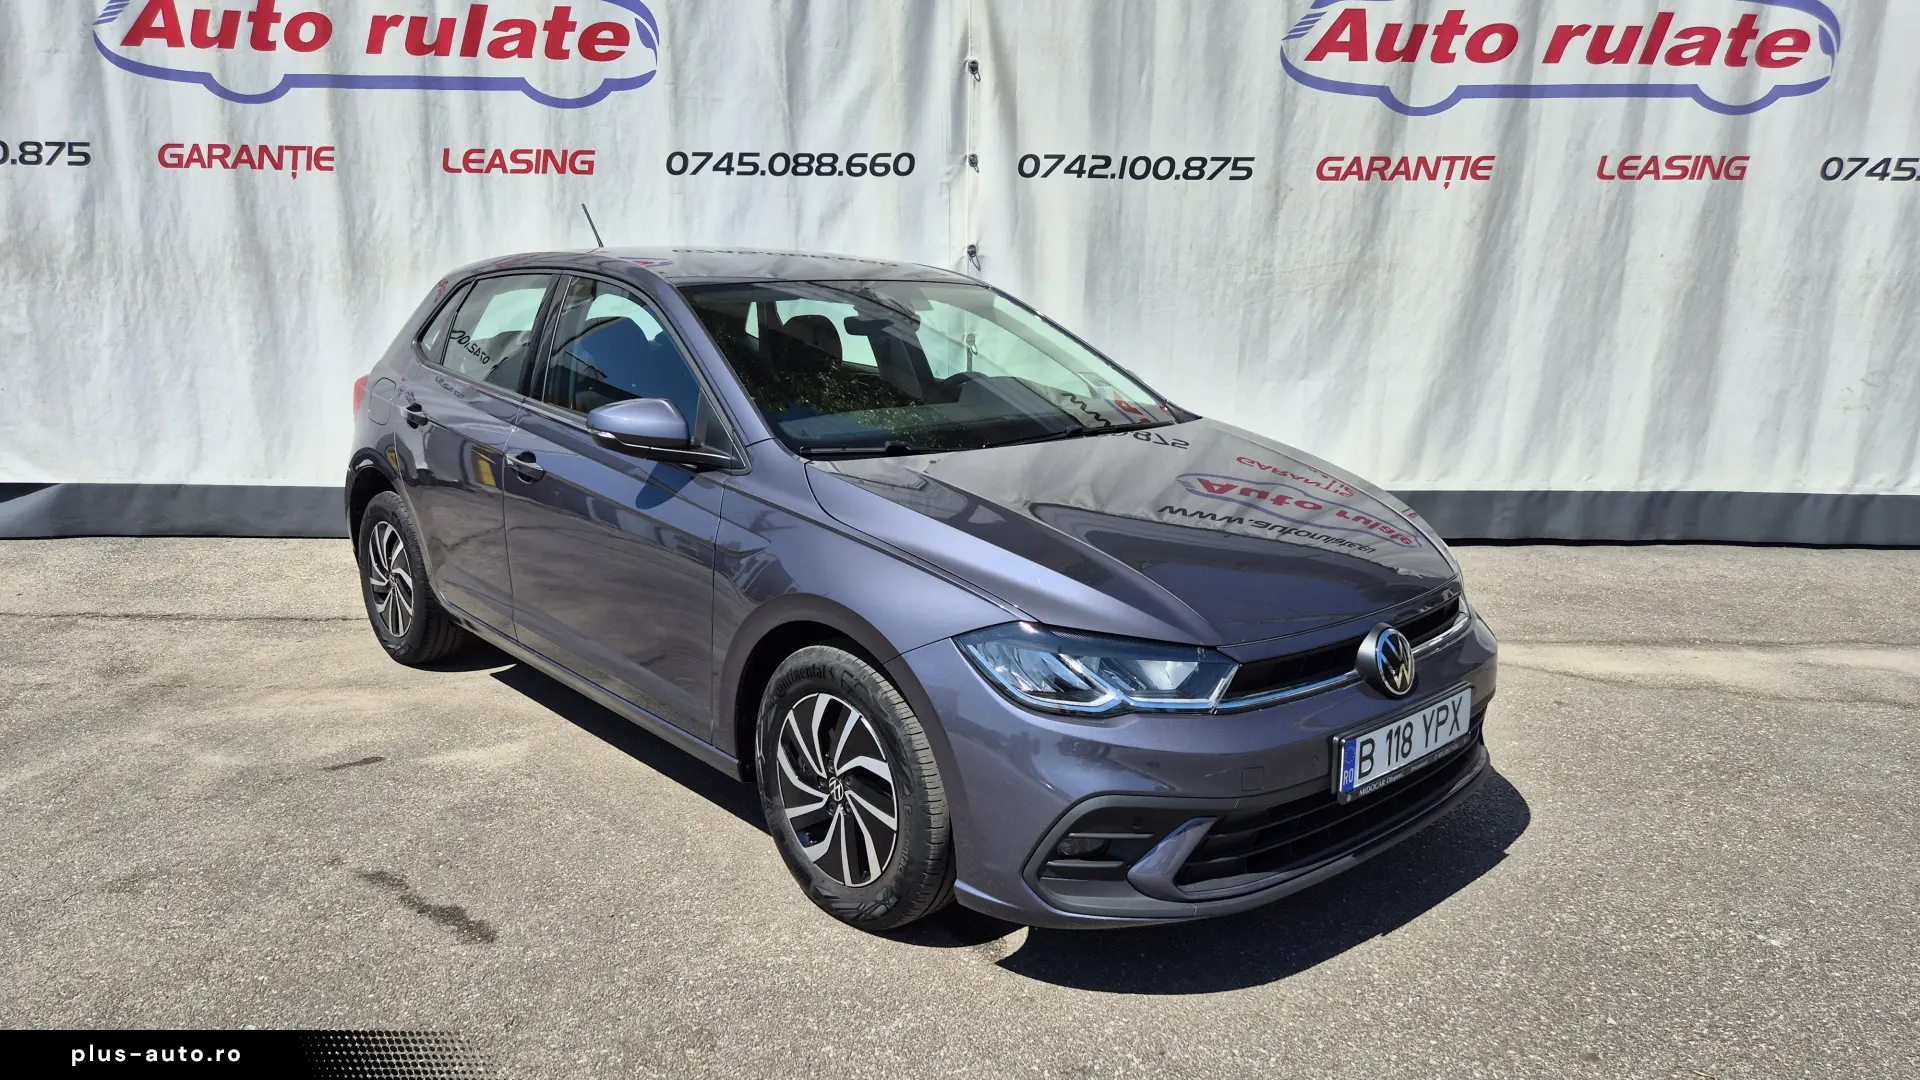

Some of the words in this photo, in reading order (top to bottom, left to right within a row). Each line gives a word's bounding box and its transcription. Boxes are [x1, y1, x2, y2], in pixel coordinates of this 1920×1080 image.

[120, 0, 333, 53] Auto
[365, 3, 631, 62] rulate
[1303, 8, 1519, 64] Auto
[1542, 11, 1811, 69] rulate
[158, 143, 335, 179] GARANȚIE
[442, 148, 595, 176] LEASING
[666, 151, 916, 178] 0745.088.660
[1017, 153, 1255, 181] 0742.100.875
[1315, 155, 1496, 189] GARANȚIE
[1597, 155, 1750, 181] LEASING
[1357, 737, 1377, 781] B
[1385, 721, 1414, 768] 118
[1422, 695, 1464, 749] YPX
[1342, 767, 1355, 787] RO
